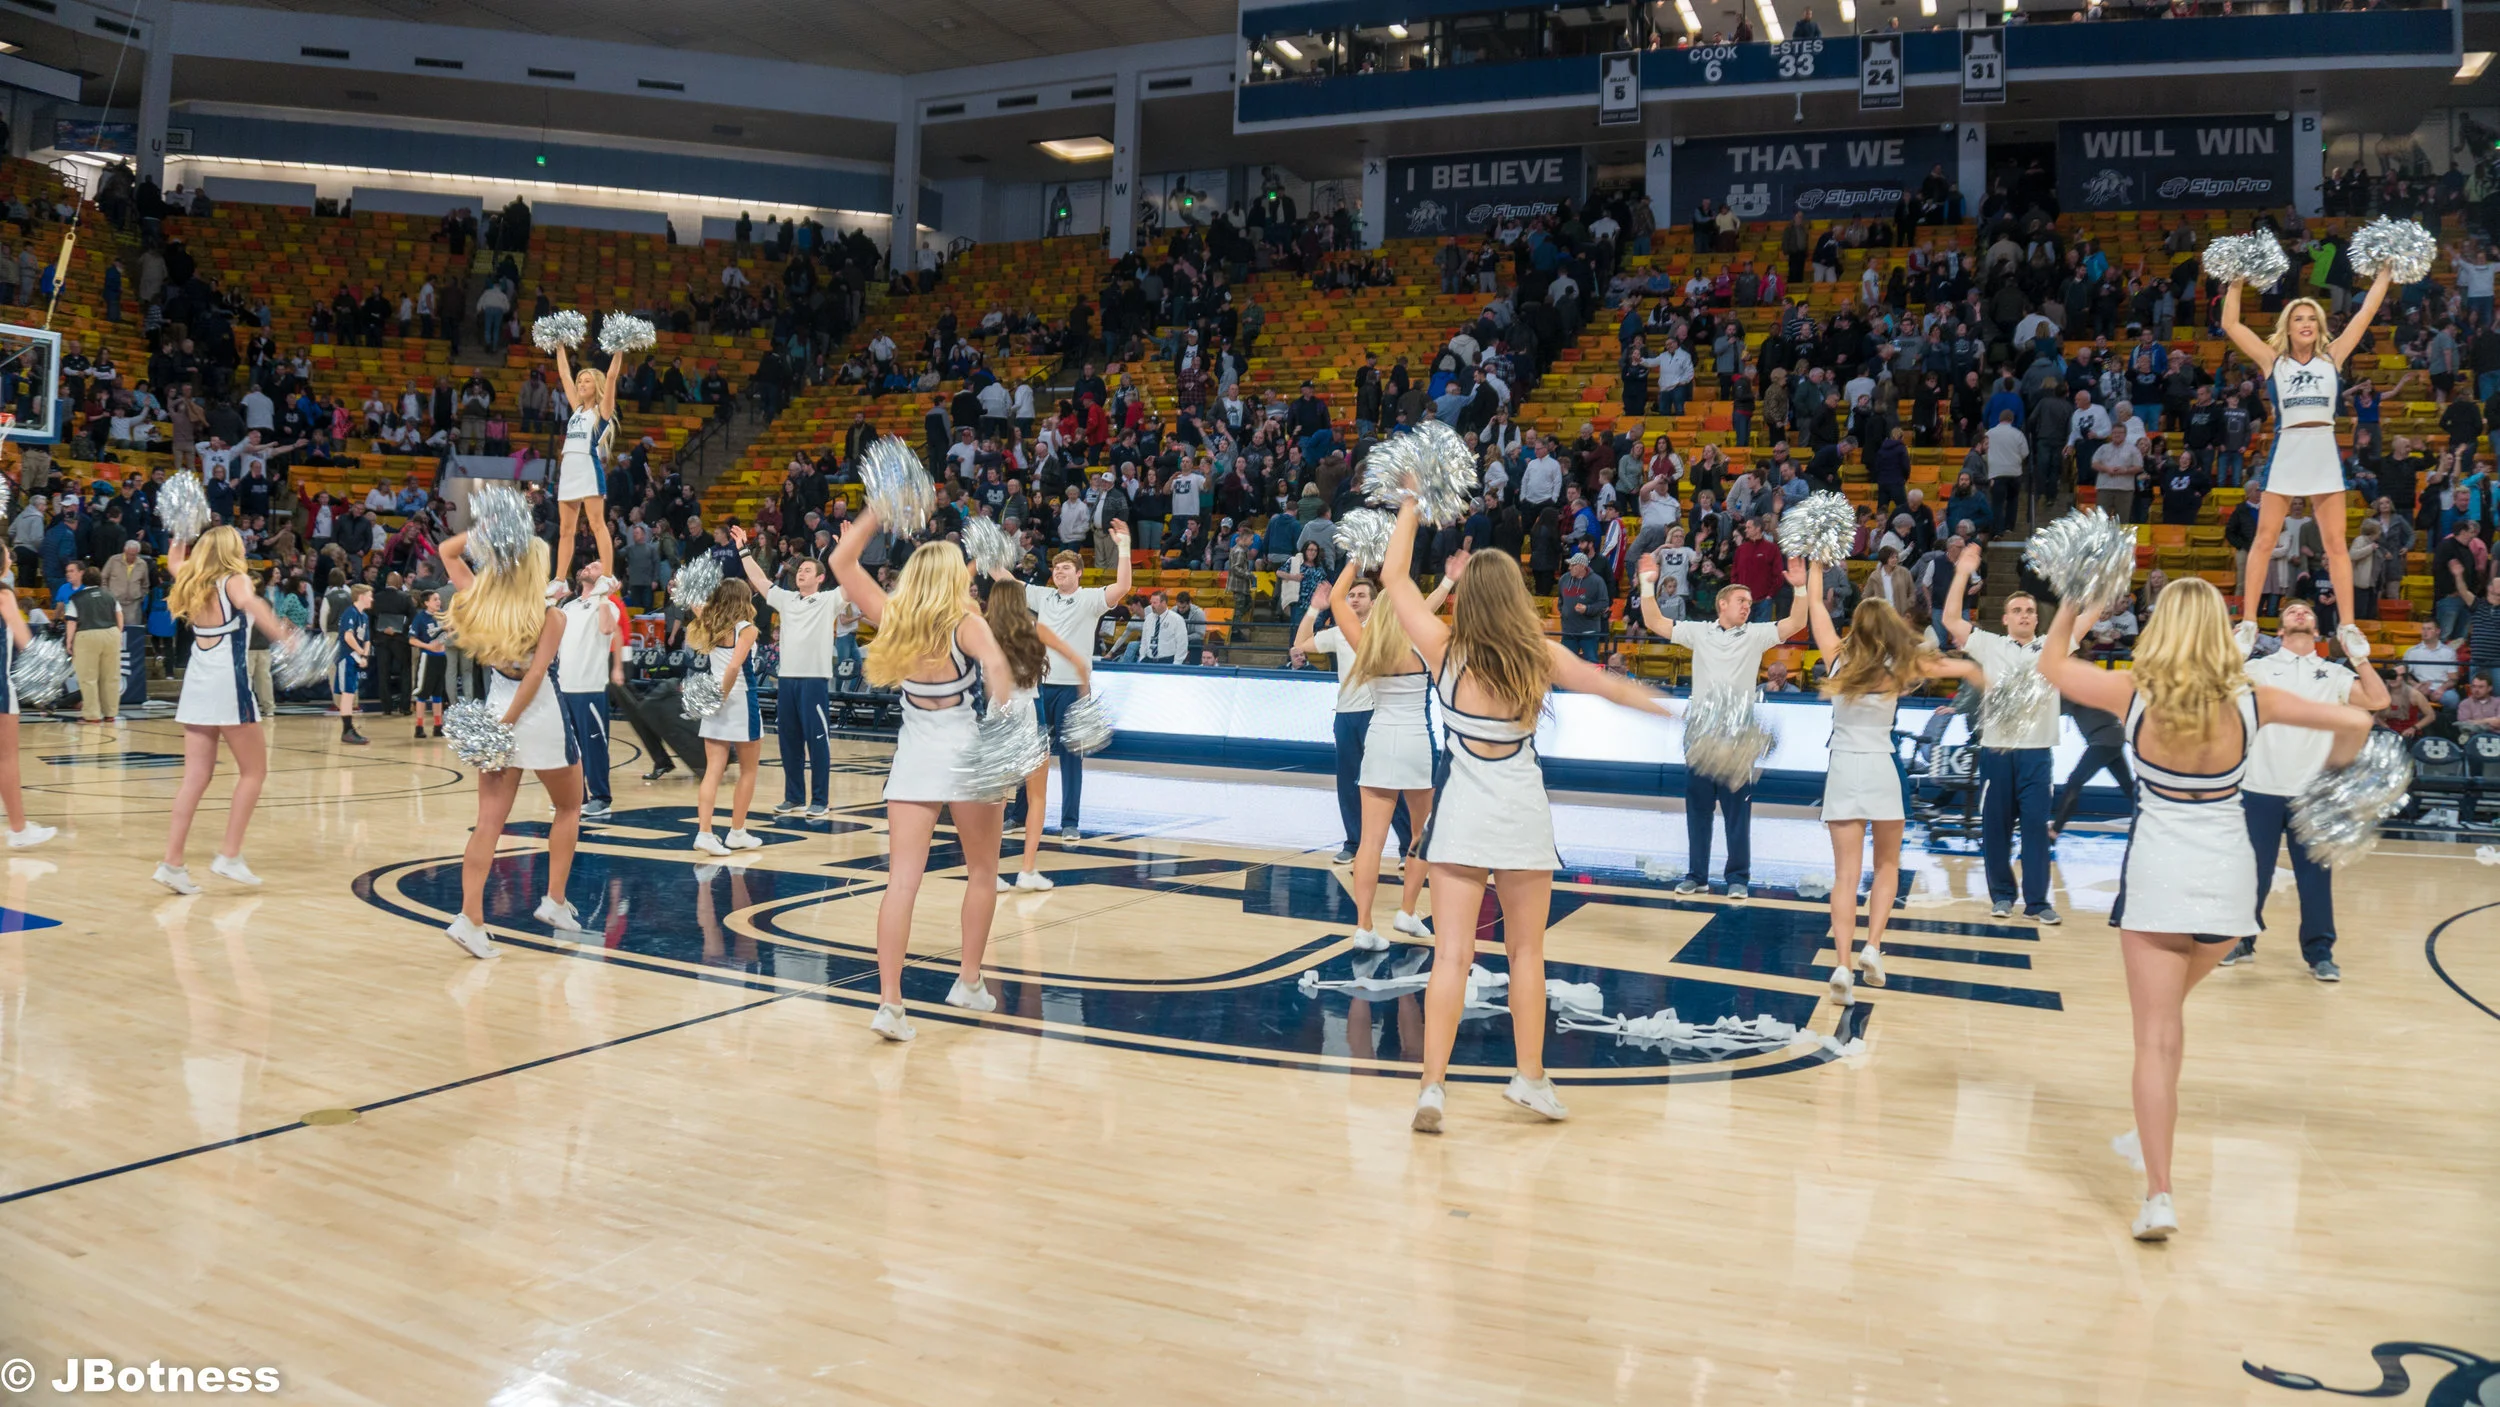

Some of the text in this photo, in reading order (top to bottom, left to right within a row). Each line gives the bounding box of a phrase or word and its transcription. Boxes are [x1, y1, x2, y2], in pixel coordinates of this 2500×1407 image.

[1689, 45, 1738, 61] COOK
[1771, 39, 1824, 56] ESTES
[1704, 59, 1723, 82] 6
[1779, 53, 1815, 77] 33
[1971, 63, 1996, 79] 31
[1867, 68, 1895, 86] 24
[1614, 86, 1626, 100] 5
[2302, 117, 2315, 132] B
[1966, 127, 1979, 142] A
[151, 138, 161, 152] U
[1652, 143, 1665, 158] A
[2083, 127, 2274, 159] WILL WIN
[1727, 138, 1905, 172] THAT WE
[1368, 162, 1379, 175] X
[1407, 167, 1415, 191] I
[1432, 157, 1563, 189] BELIEVE
[1114, 183, 1128, 196] W
[2189, 177, 2233, 197] Sign
[2233, 176, 2272, 193] Pro
[1825, 188, 1868, 207] Sign
[1868, 187, 1903, 202] Pro
[896, 203, 904, 215] V
[1492, 203, 1531, 221] Sign
